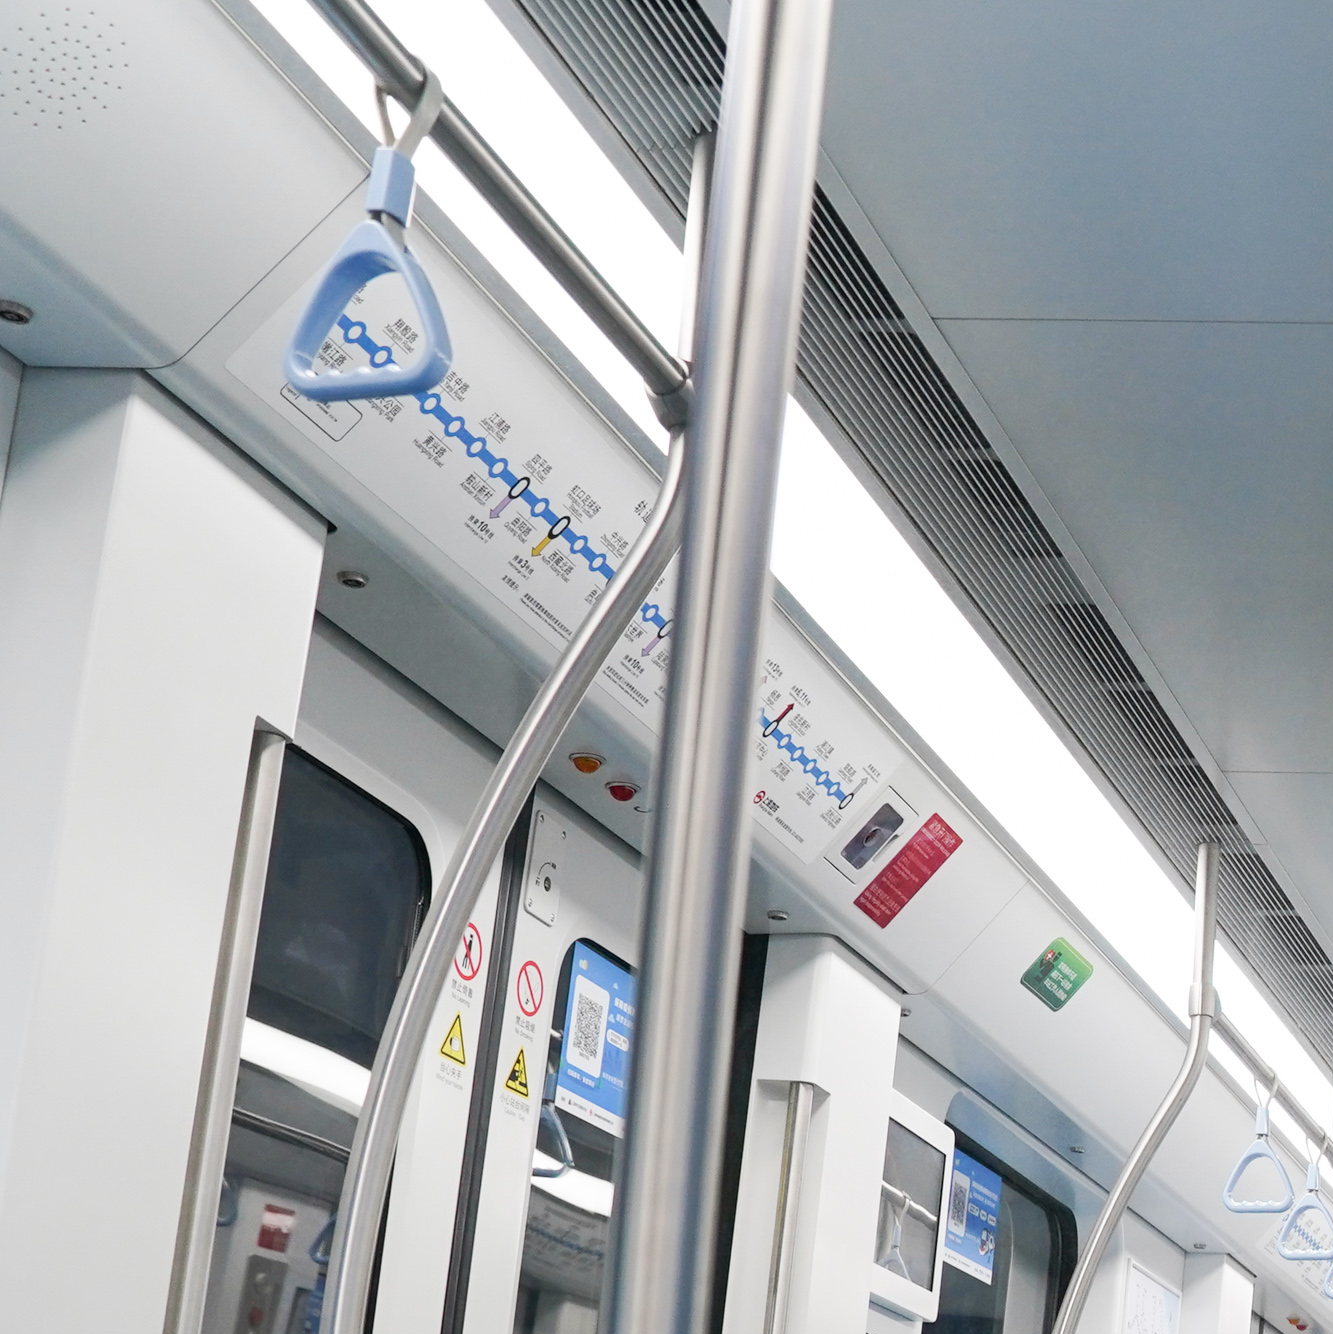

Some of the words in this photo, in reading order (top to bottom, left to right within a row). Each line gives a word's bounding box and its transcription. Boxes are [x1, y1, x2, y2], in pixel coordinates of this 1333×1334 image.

[393, 318, 419, 344] 翔殷路
[446, 371, 470, 394] 吉中路
[375, 397, 401, 417] 兴公园
[488, 412, 511, 434] 江浦路
[423, 435, 447, 458] 黄兴路
[531, 454, 552, 475] 四平路
[465, 474, 493, 501] 鞍山新村
